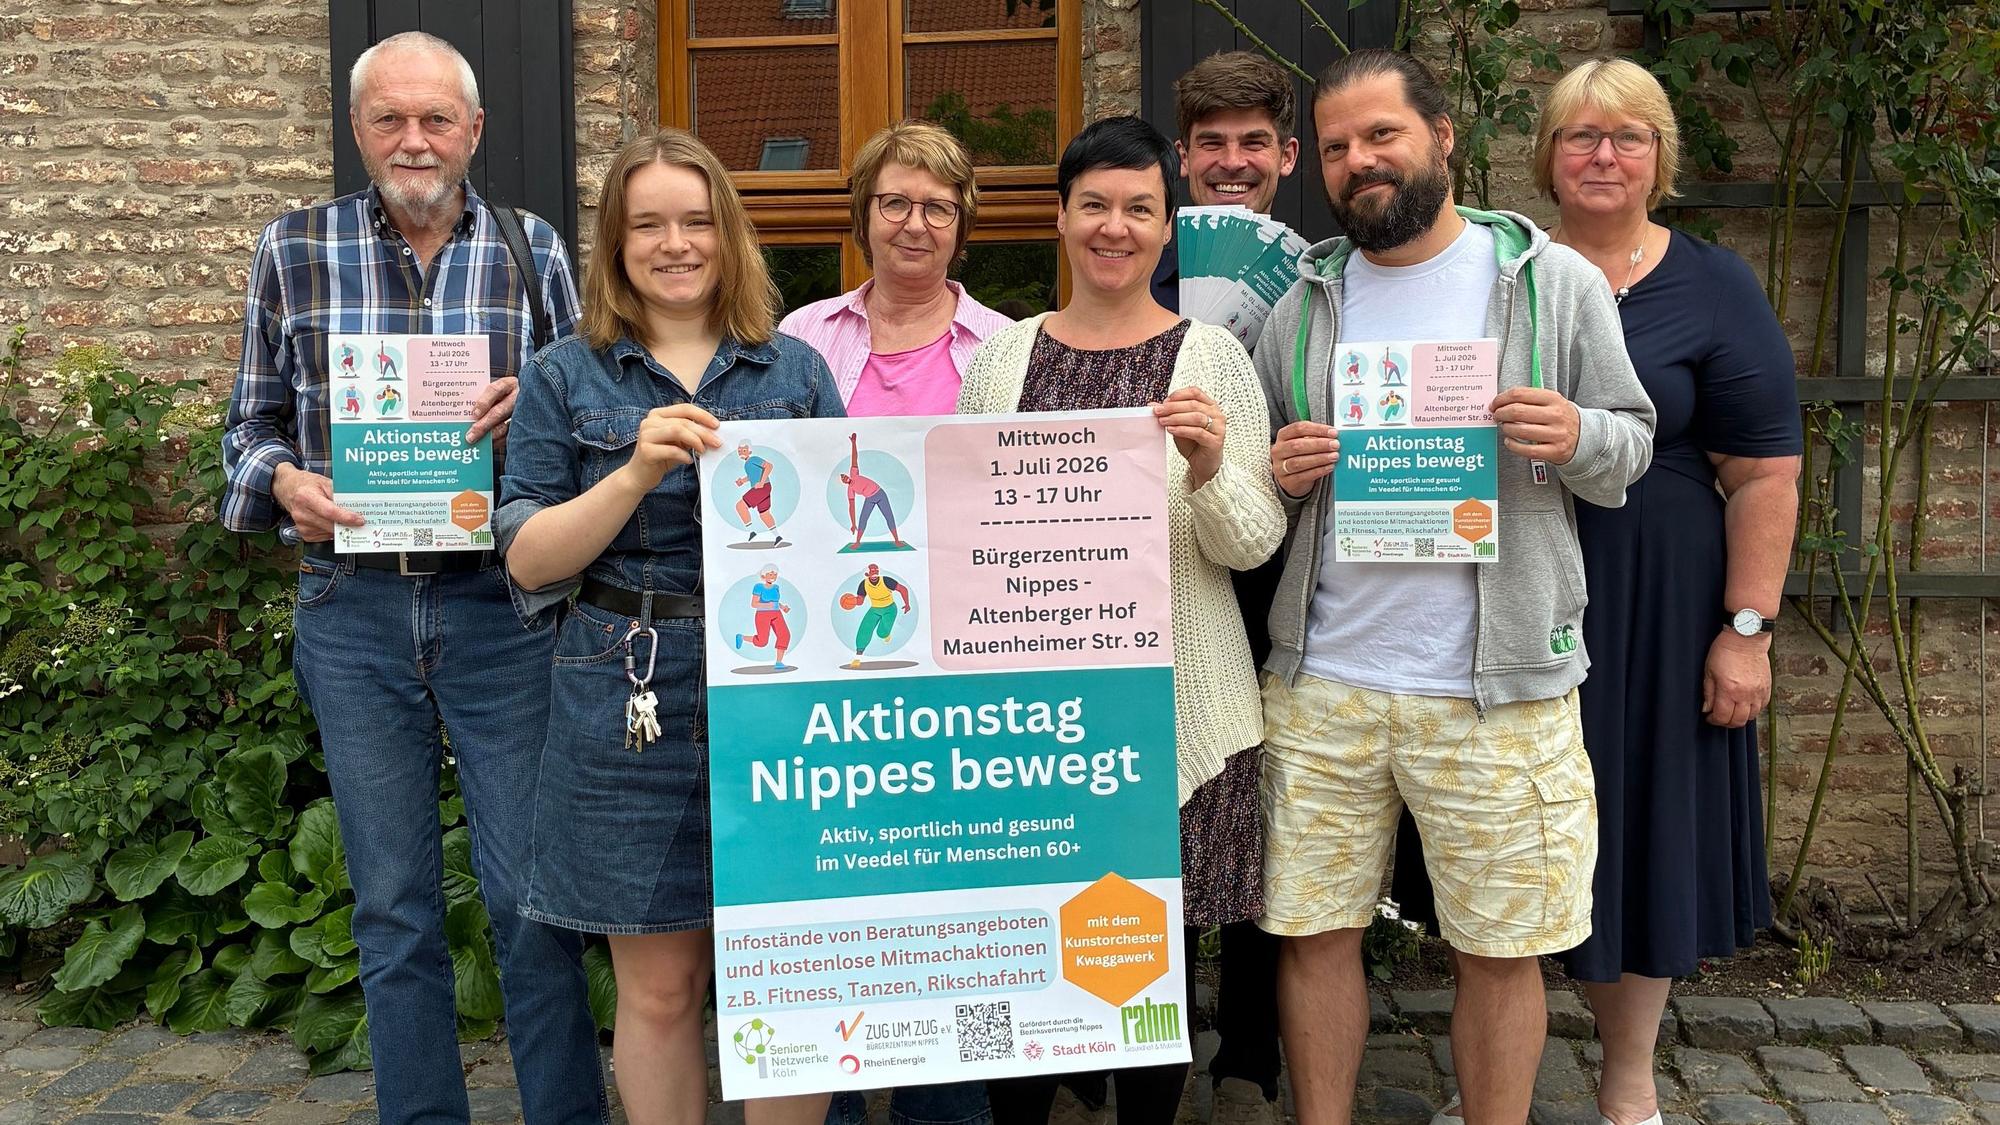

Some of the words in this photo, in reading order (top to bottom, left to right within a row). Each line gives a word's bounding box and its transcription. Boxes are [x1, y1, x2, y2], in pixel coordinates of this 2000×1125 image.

[1281, 255, 1303, 279] Nippe
[1271, 264, 1294, 288] beweg
[1437, 344, 1473, 352] Mittwoch
[1442, 354, 1457, 362] Juli
[1457, 354, 1477, 362] 2026
[422, 380, 477, 389] Bürgerzentrum
[1426, 384, 1483, 394] Bürgerzentrum
[434, 389, 460, 398] Nippes
[1438, 394, 1464, 403] Nippes
[421, 399, 464, 408] Altenberger
[1424, 405, 1469, 413] Altenberger
[412, 409, 462, 417] Mauenheimer
[363, 429, 462, 447] Aktionstag
[997, 428, 1096, 447] Mittwoch
[1365, 435, 1465, 454] Aktionstag
[345, 447, 410, 465] Nippes
[414, 446, 480, 465] bewegt
[1347, 454, 1411, 472] Nippes
[1416, 453, 1485, 472] bewegt
[389, 469, 418, 478] sportlich
[433, 469, 457, 477] gesund
[990, 459, 1009, 476] 1.
[1012, 457, 1051, 476] Juli
[1055, 455, 1109, 475] 2026
[412, 477, 445, 485] Menschen
[1370, 477, 1390, 485] Aktiv,
[1390, 477, 1421, 485] sportlich
[1435, 477, 1460, 485] gesund
[993, 488, 1016, 506] 13
[1036, 486, 1058, 504] 17
[1063, 485, 1102, 503] Uhr
[1385, 510, 1450, 518] Beratungsangeboten
[470, 529, 492, 544] rahm
[1351, 527, 1378, 535] Fitness,
[971, 544, 1129, 569] Bürgerzentrum
[1473, 540, 1496, 556] rahm
[1005, 575, 1079, 598] Nippes
[968, 605, 1092, 629] Altenberger
[1098, 601, 1137, 620] Hof
[942, 634, 1086, 657] Mauenheimer
[1091, 633, 1129, 650] Str.
[1133, 630, 1159, 649] 92
[802, 696, 1086, 745] Aktionstag
[751, 755, 936, 811] Nippes
[951, 744, 1141, 795] bewegt
[819, 824, 874, 846] Aktiv,
[878, 819, 963, 844] sportlich
[968, 817, 1003, 835] und
[1008, 814, 1075, 837] gesund
[815, 854, 839, 872] im
[843, 849, 909, 870] Veedel
[913, 847, 941, 866] für
[946, 842, 1041, 863] Menschen
[1046, 840, 1081, 857] 60+
[1086, 914, 1108, 928] mit
[1112, 913, 1140, 927] dem
[725, 929, 824, 952] Infostände
[828, 928, 861, 944] von
[866, 913, 1049, 943] Beratungsangeboten
[1064, 931, 1165, 949] Kunstorchester
[725, 960, 764, 980] und
[769, 952, 875, 977] kostenlose
[880, 939, 1047, 968] Mitmachaktionen
[1075, 950, 1156, 969] Kwaggawerk
[727, 990, 762, 1009] z.B.
[767, 982, 843, 1006] Fitness,
[848, 977, 923, 999] Tanzen,
[927, 967, 1047, 993] Rikschafahrt
[865, 1023, 890, 1040] ZUG
[892, 1021, 911, 1038] UM
[913, 1019, 938, 1036] ZUG
[1019, 1019, 1052, 1029] Gefördert
[1053, 1018, 1072, 1026] durch
[1073, 1016, 1084, 1024] die
[1121, 997, 1181, 1045] rahm
[1019, 1026, 1079, 1037] Bezirksvertretung
[1079, 1024, 1103, 1033] Nippes
[769, 1044, 818, 1055] Senioren
[866, 1039, 917, 1051] BÜRGERZENTRUM
[918, 1037, 939, 1047] NIPPES
[1052, 1042, 1086, 1057] Stadt
[1088, 1040, 1116, 1054] Köln
[771, 1054, 829, 1067] Netzwerke
[863, 1054, 926, 1069] RheinEnergie
[772, 1067, 797, 1079] Köln
